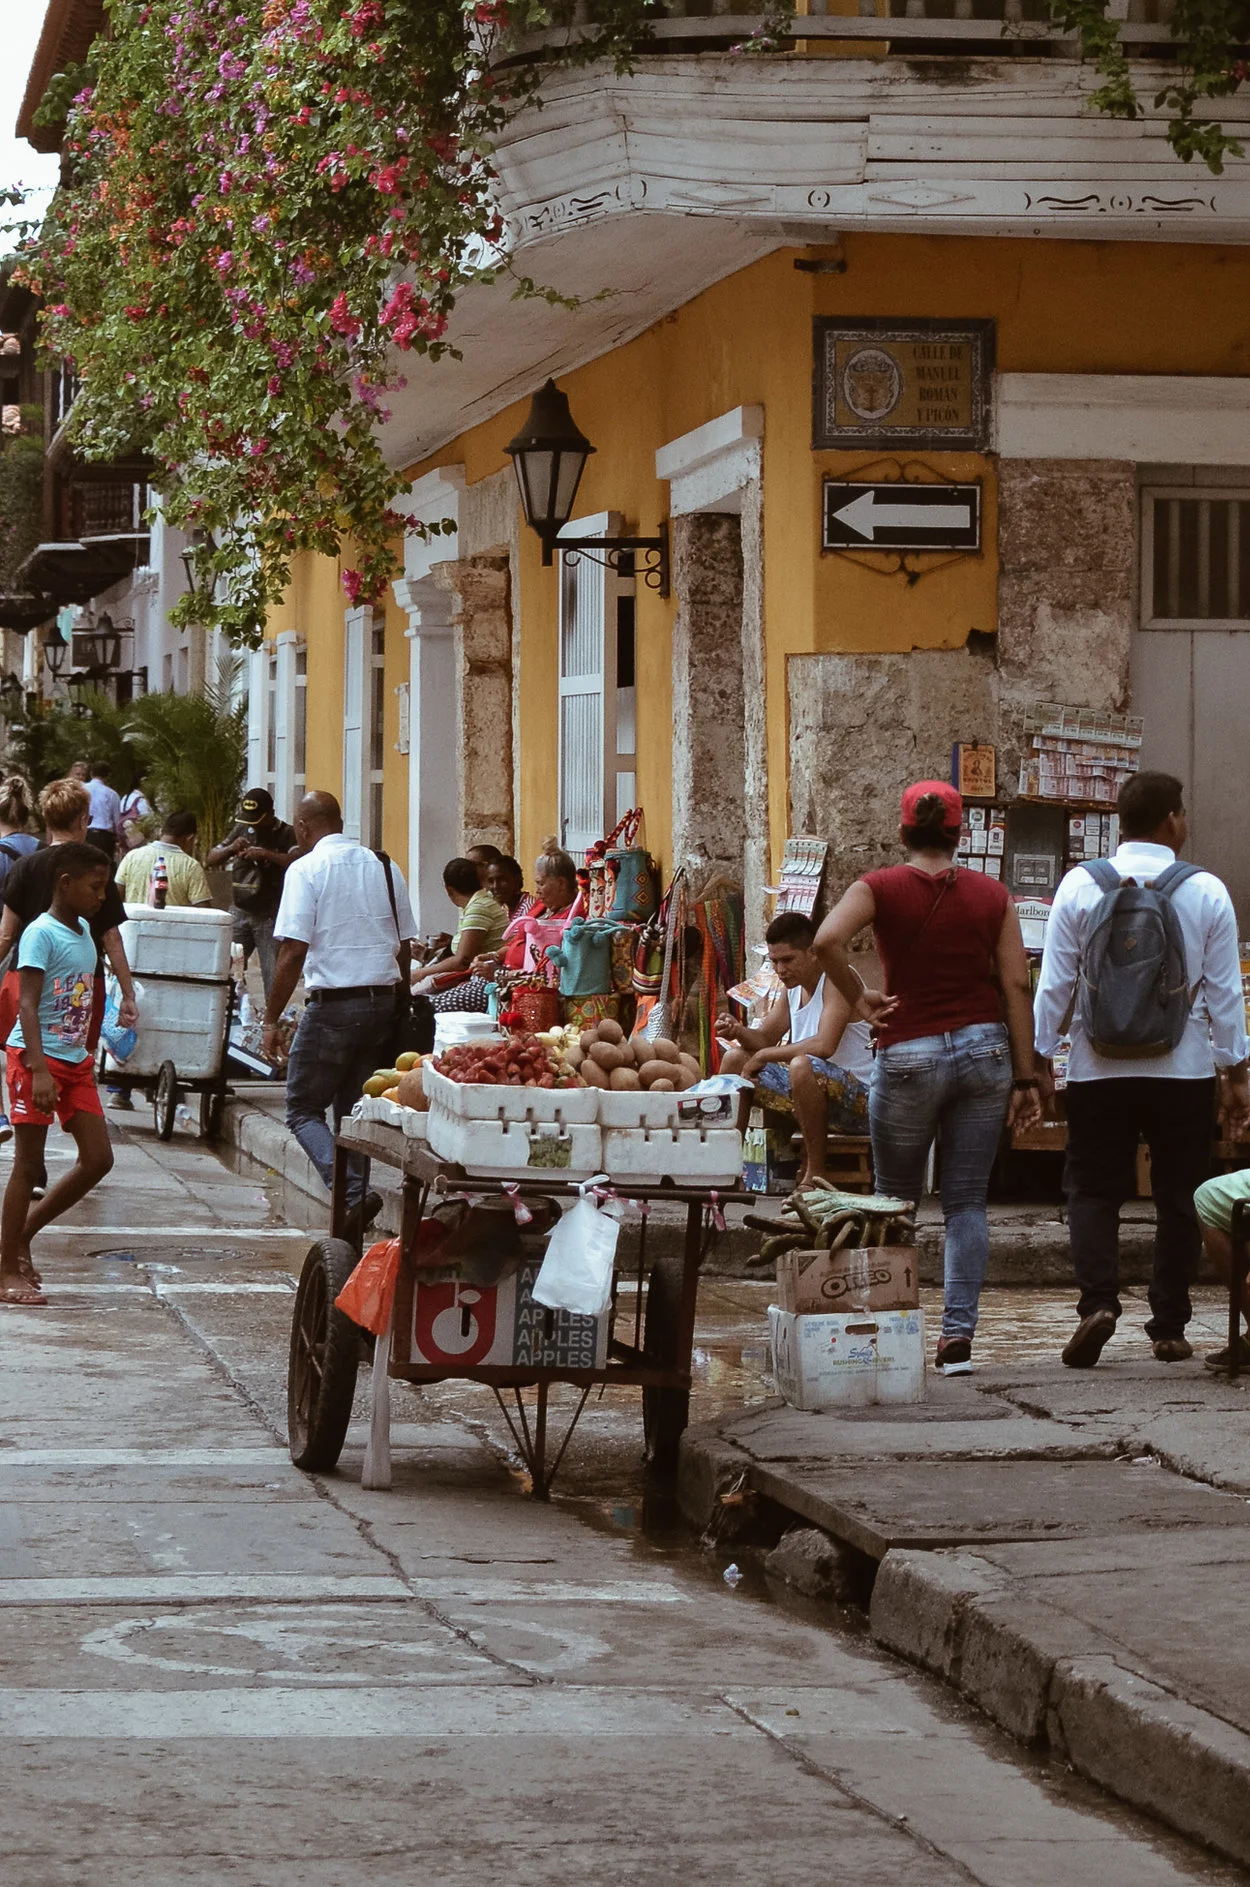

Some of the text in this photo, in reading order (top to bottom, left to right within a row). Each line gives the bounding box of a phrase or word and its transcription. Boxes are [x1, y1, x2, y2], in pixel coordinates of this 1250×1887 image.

[912, 344, 963, 361] CALLE DE
[915, 365, 960, 381] MANUEL
[916, 404, 960, 423] Y PICÓN
[1017, 904, 1050, 918] arlbor
[518, 1308, 594, 1328] APLES
[517, 1329, 593, 1348] ALES
[516, 1349, 592, 1369] APPLES
